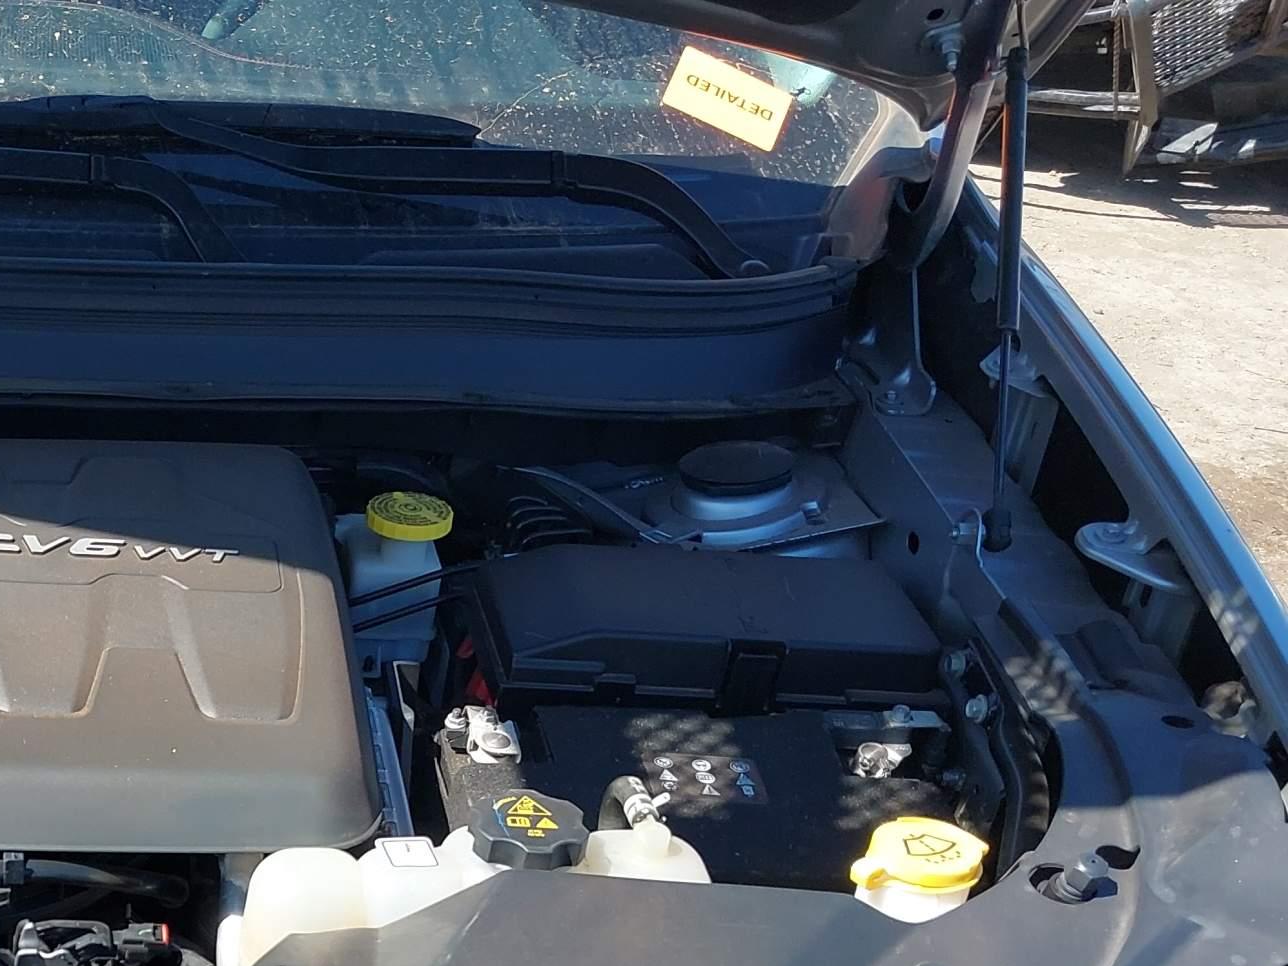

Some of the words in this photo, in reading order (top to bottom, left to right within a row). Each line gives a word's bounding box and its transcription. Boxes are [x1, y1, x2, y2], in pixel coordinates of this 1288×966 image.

[686, 74, 774, 121] DETAILED
[22, 534, 127, 556] V6
[134, 544, 240, 563] VVT
